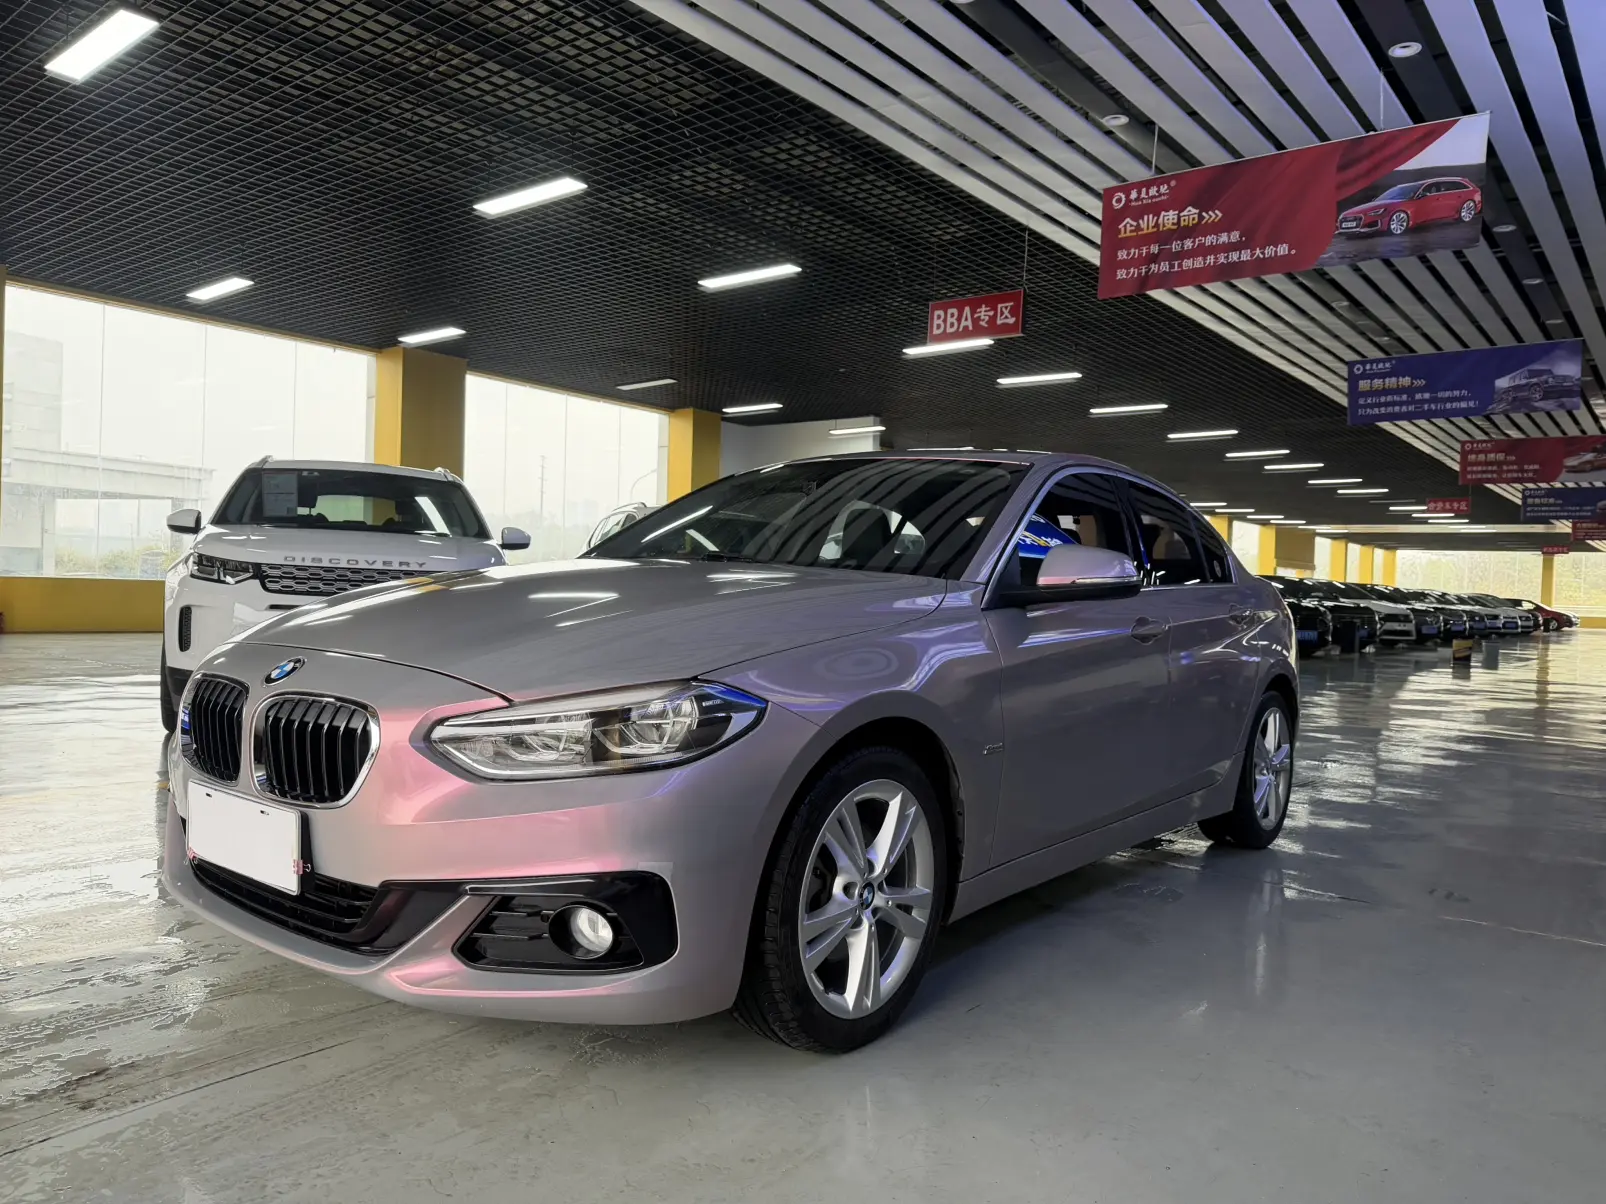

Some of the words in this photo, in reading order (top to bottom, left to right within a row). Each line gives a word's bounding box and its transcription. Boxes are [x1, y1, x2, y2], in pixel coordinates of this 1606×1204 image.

[1118, 205, 1200, 238] 企业使命
[932, 301, 1017, 335] BBA专区
[1358, 375, 1412, 392] 服务精神
[283, 555, 427, 568] DISCOVERY
